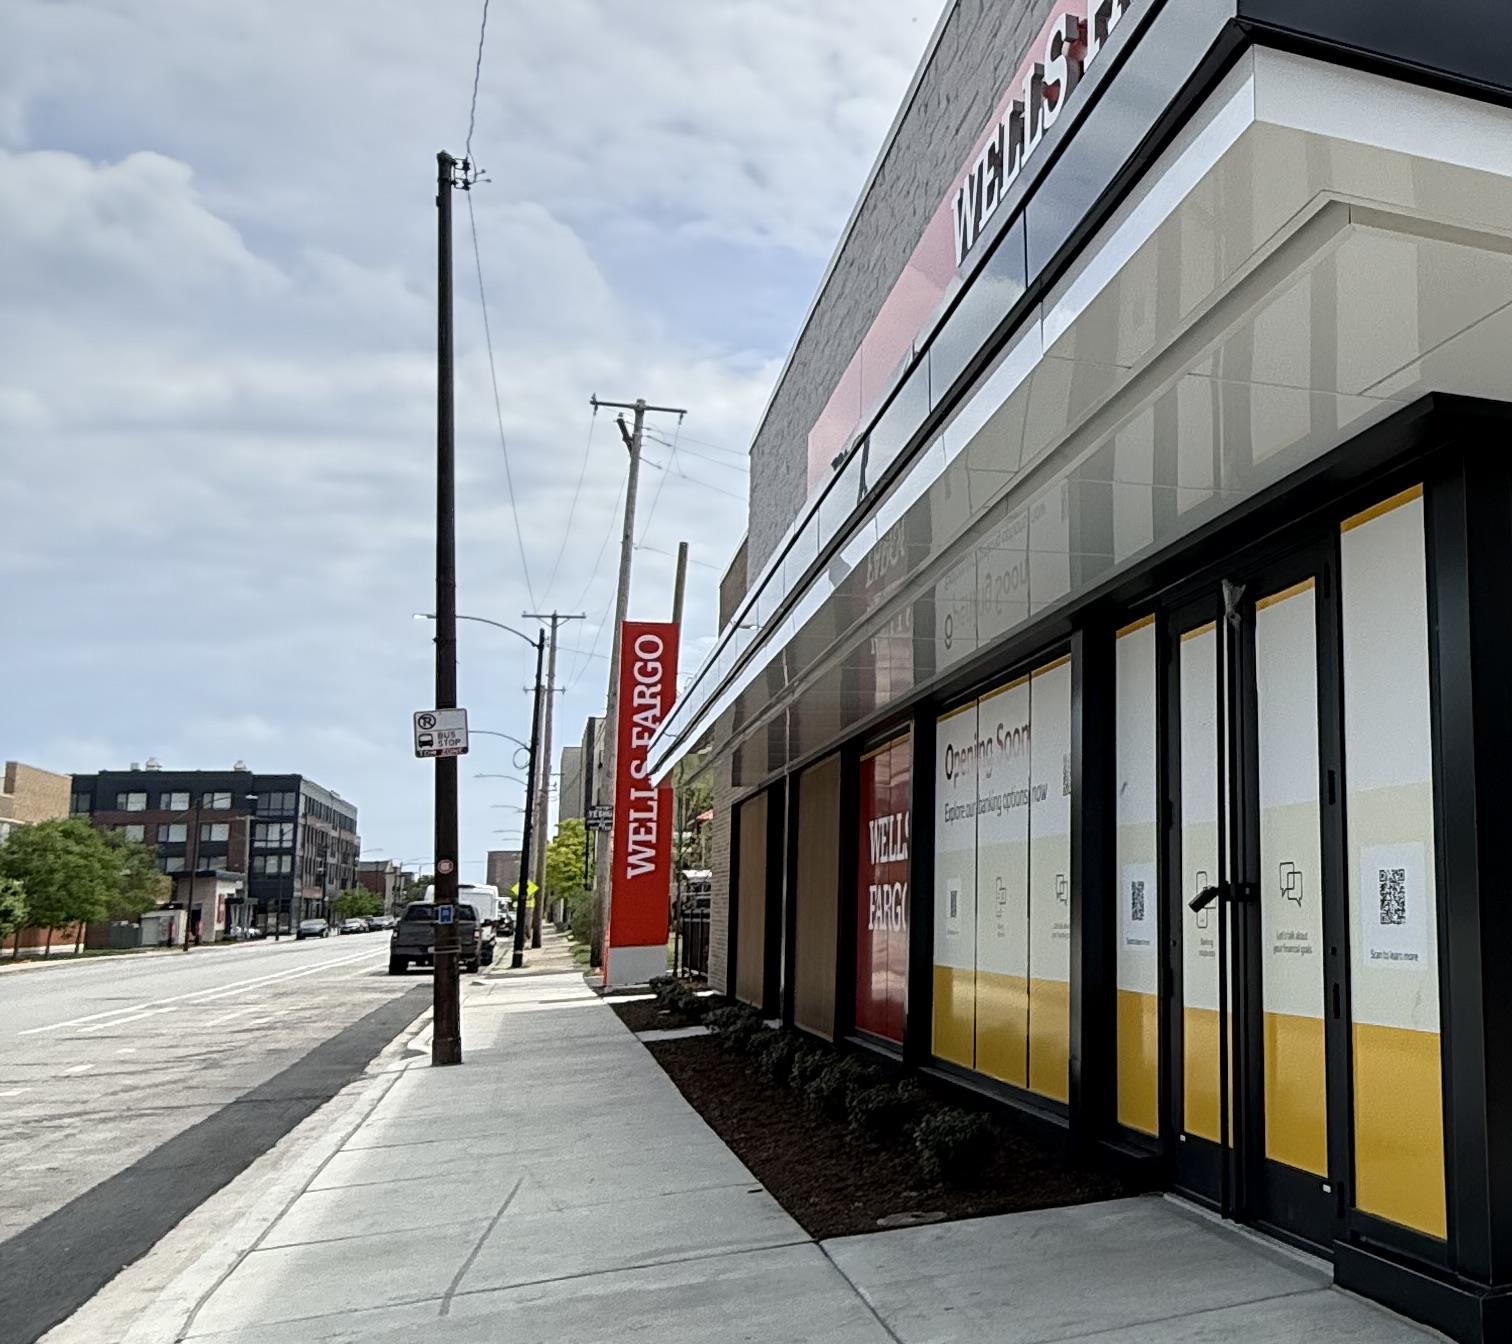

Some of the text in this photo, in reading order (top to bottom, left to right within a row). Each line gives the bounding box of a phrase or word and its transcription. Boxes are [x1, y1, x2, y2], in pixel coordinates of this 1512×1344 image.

[951, 12, 1076, 267] WELLS
[631, 633, 664, 750] FARGO
[437, 730, 456, 740] BUS
[438, 738, 462, 747] STOP
[945, 722, 1031, 788] Opening Soon
[1032, 783, 1047, 802] now
